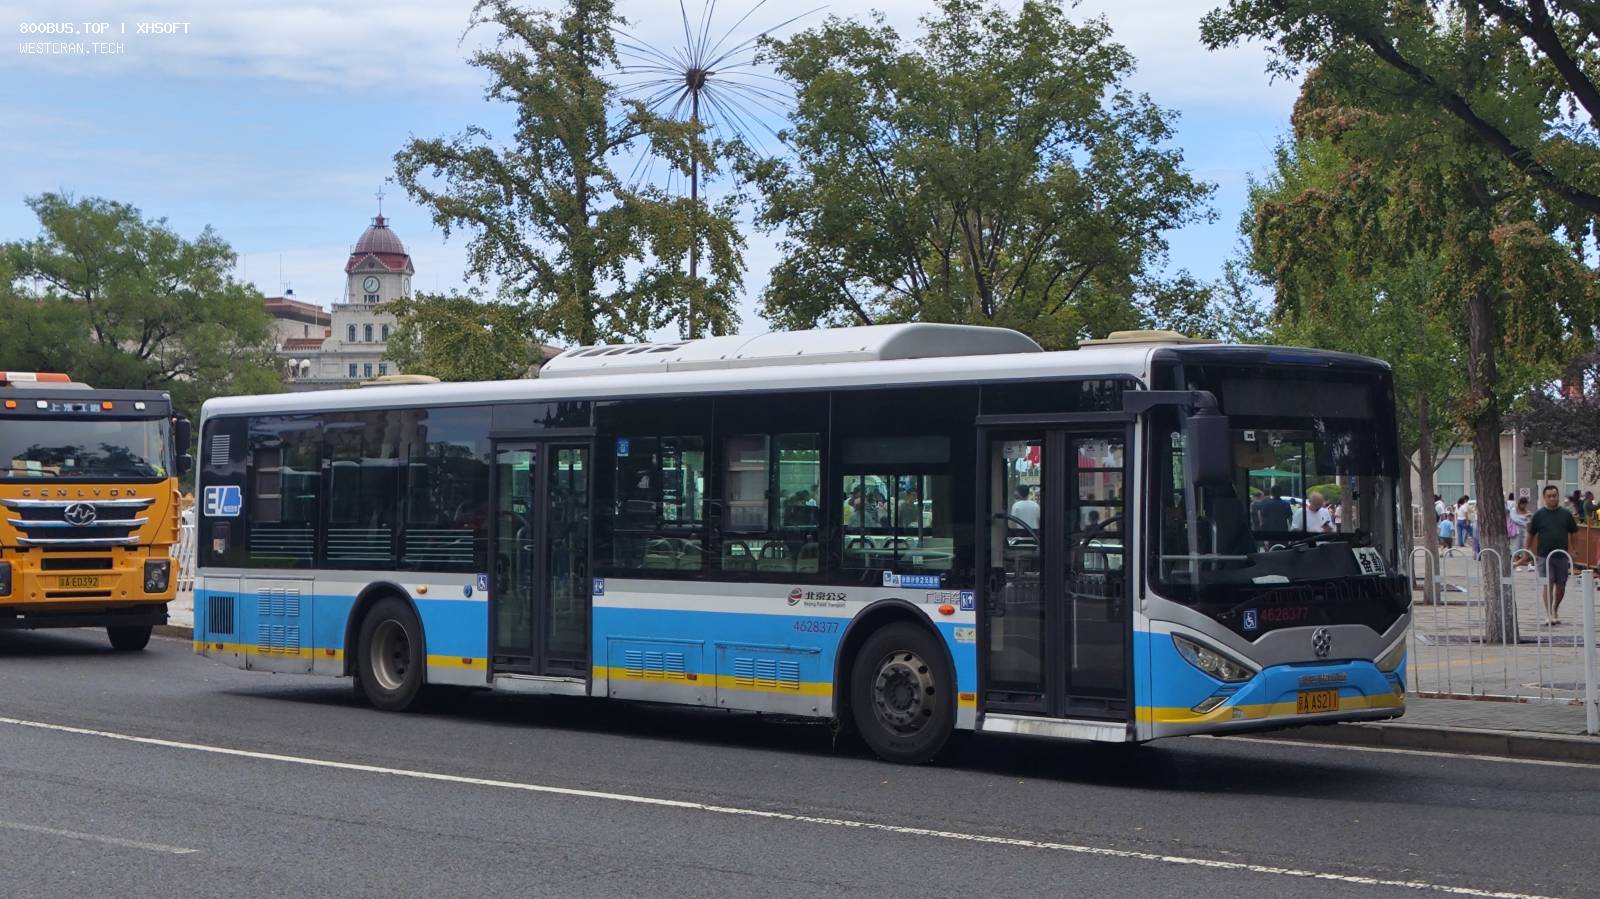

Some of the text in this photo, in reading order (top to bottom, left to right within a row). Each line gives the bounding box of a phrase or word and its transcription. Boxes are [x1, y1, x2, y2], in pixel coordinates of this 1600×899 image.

[805, 591, 847, 601] 北京公交
[793, 620, 840, 633] 4628377
